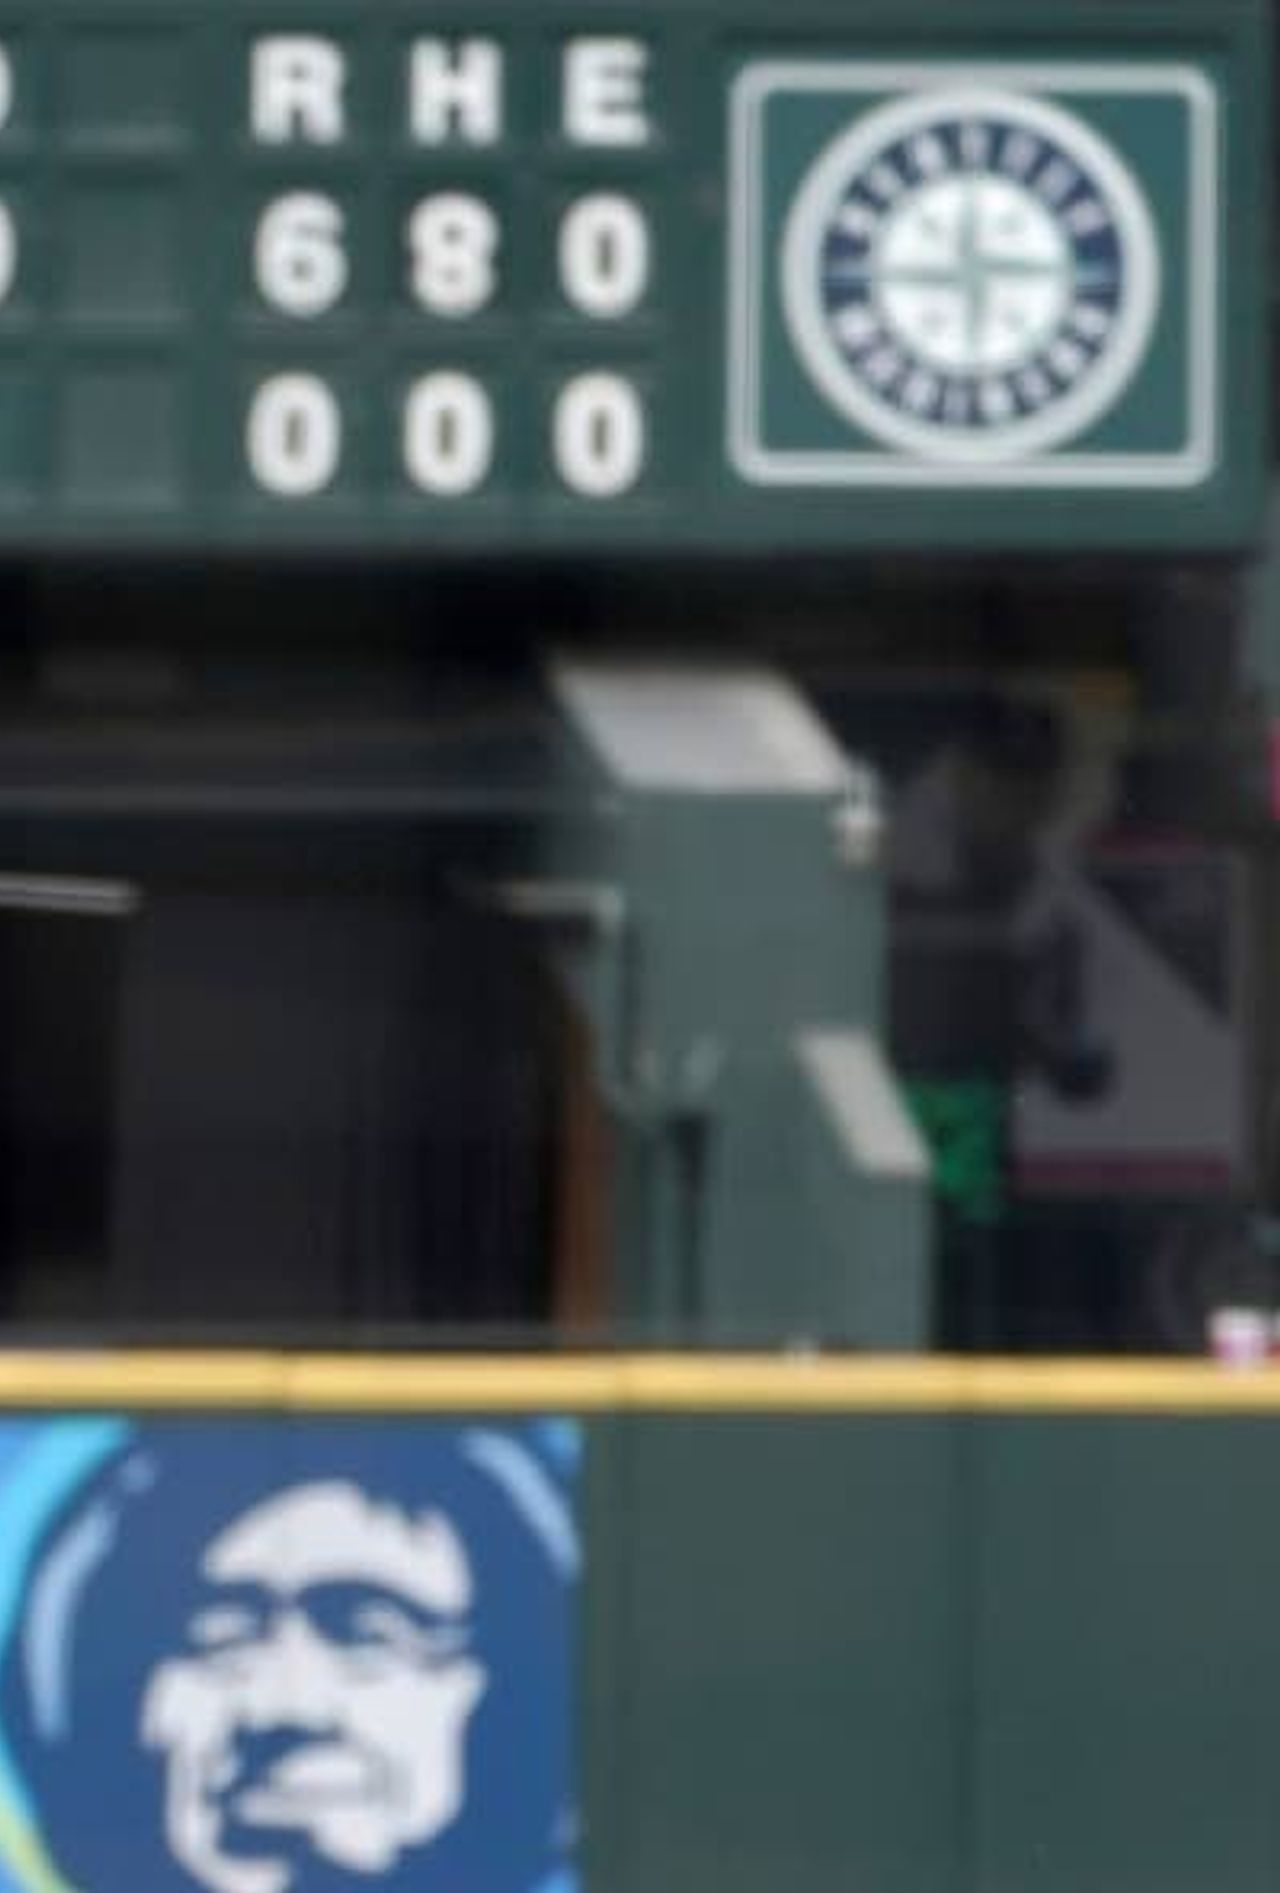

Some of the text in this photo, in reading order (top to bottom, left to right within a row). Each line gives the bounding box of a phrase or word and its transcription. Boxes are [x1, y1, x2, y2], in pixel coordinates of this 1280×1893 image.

[252, 37, 344, 142] R
[411, 40, 501, 143] H
[564, 39, 649, 146] E
[256, 193, 346, 315] 6
[410, 194, 496, 314] 8
[560, 195, 648, 317] 0
[248, 374, 339, 495] 0
[404, 372, 492, 494] 0
[555, 373, 643, 496] 0
